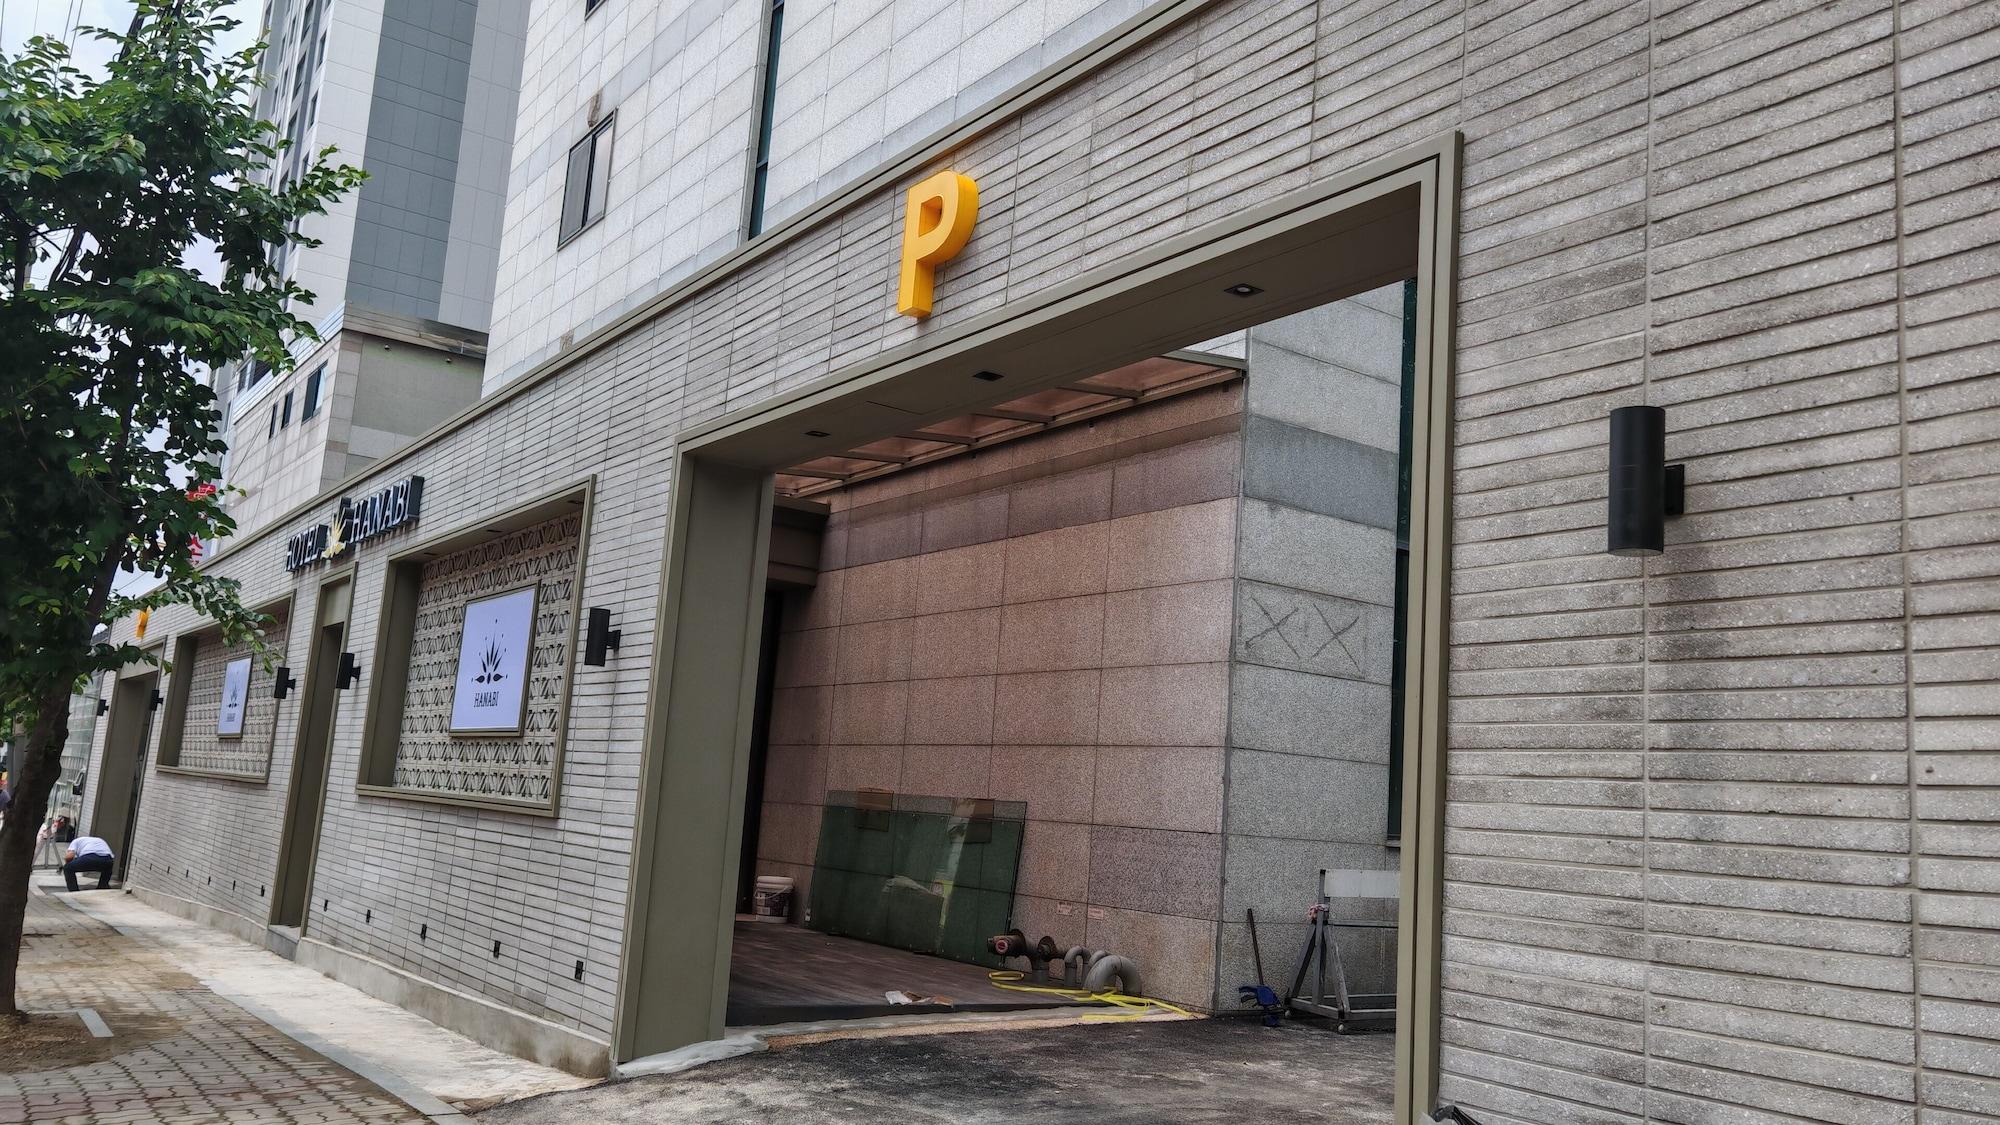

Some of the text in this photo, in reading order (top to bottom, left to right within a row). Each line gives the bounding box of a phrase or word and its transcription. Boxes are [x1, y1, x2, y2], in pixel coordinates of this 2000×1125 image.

[897, 170, 979, 318] P
[285, 475, 424, 572] HOTEL HANABI
[474, 691, 499, 708] HANABI
